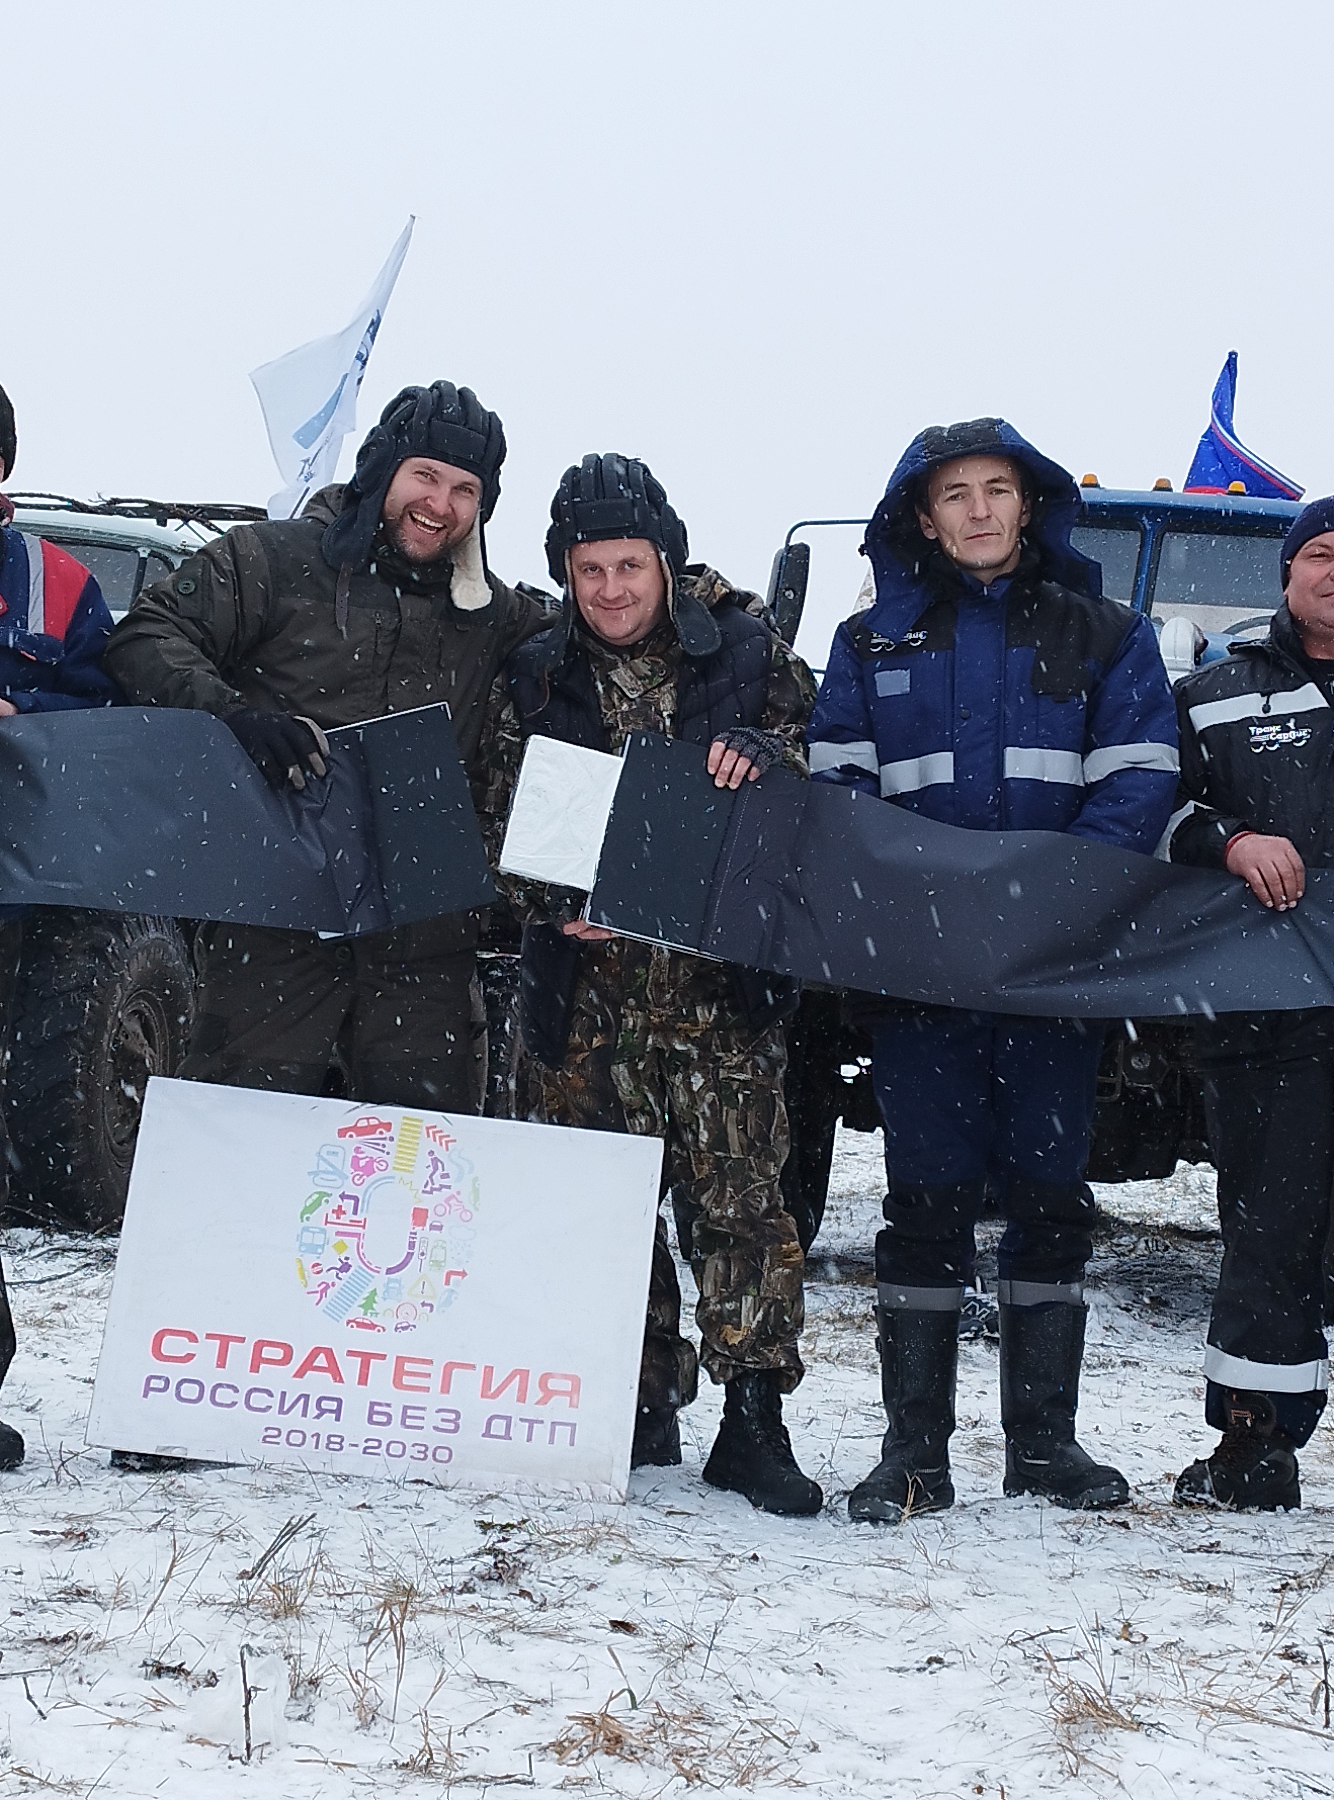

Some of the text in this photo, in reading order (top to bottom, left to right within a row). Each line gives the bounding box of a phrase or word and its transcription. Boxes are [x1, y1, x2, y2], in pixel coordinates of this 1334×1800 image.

[150, 1327, 582, 1409] СТРАТЕГИЯ
[142, 1373, 577, 1447] РОССИЯ БЕЗ ДТП
[261, 1425, 454, 1465] 2018-2030
